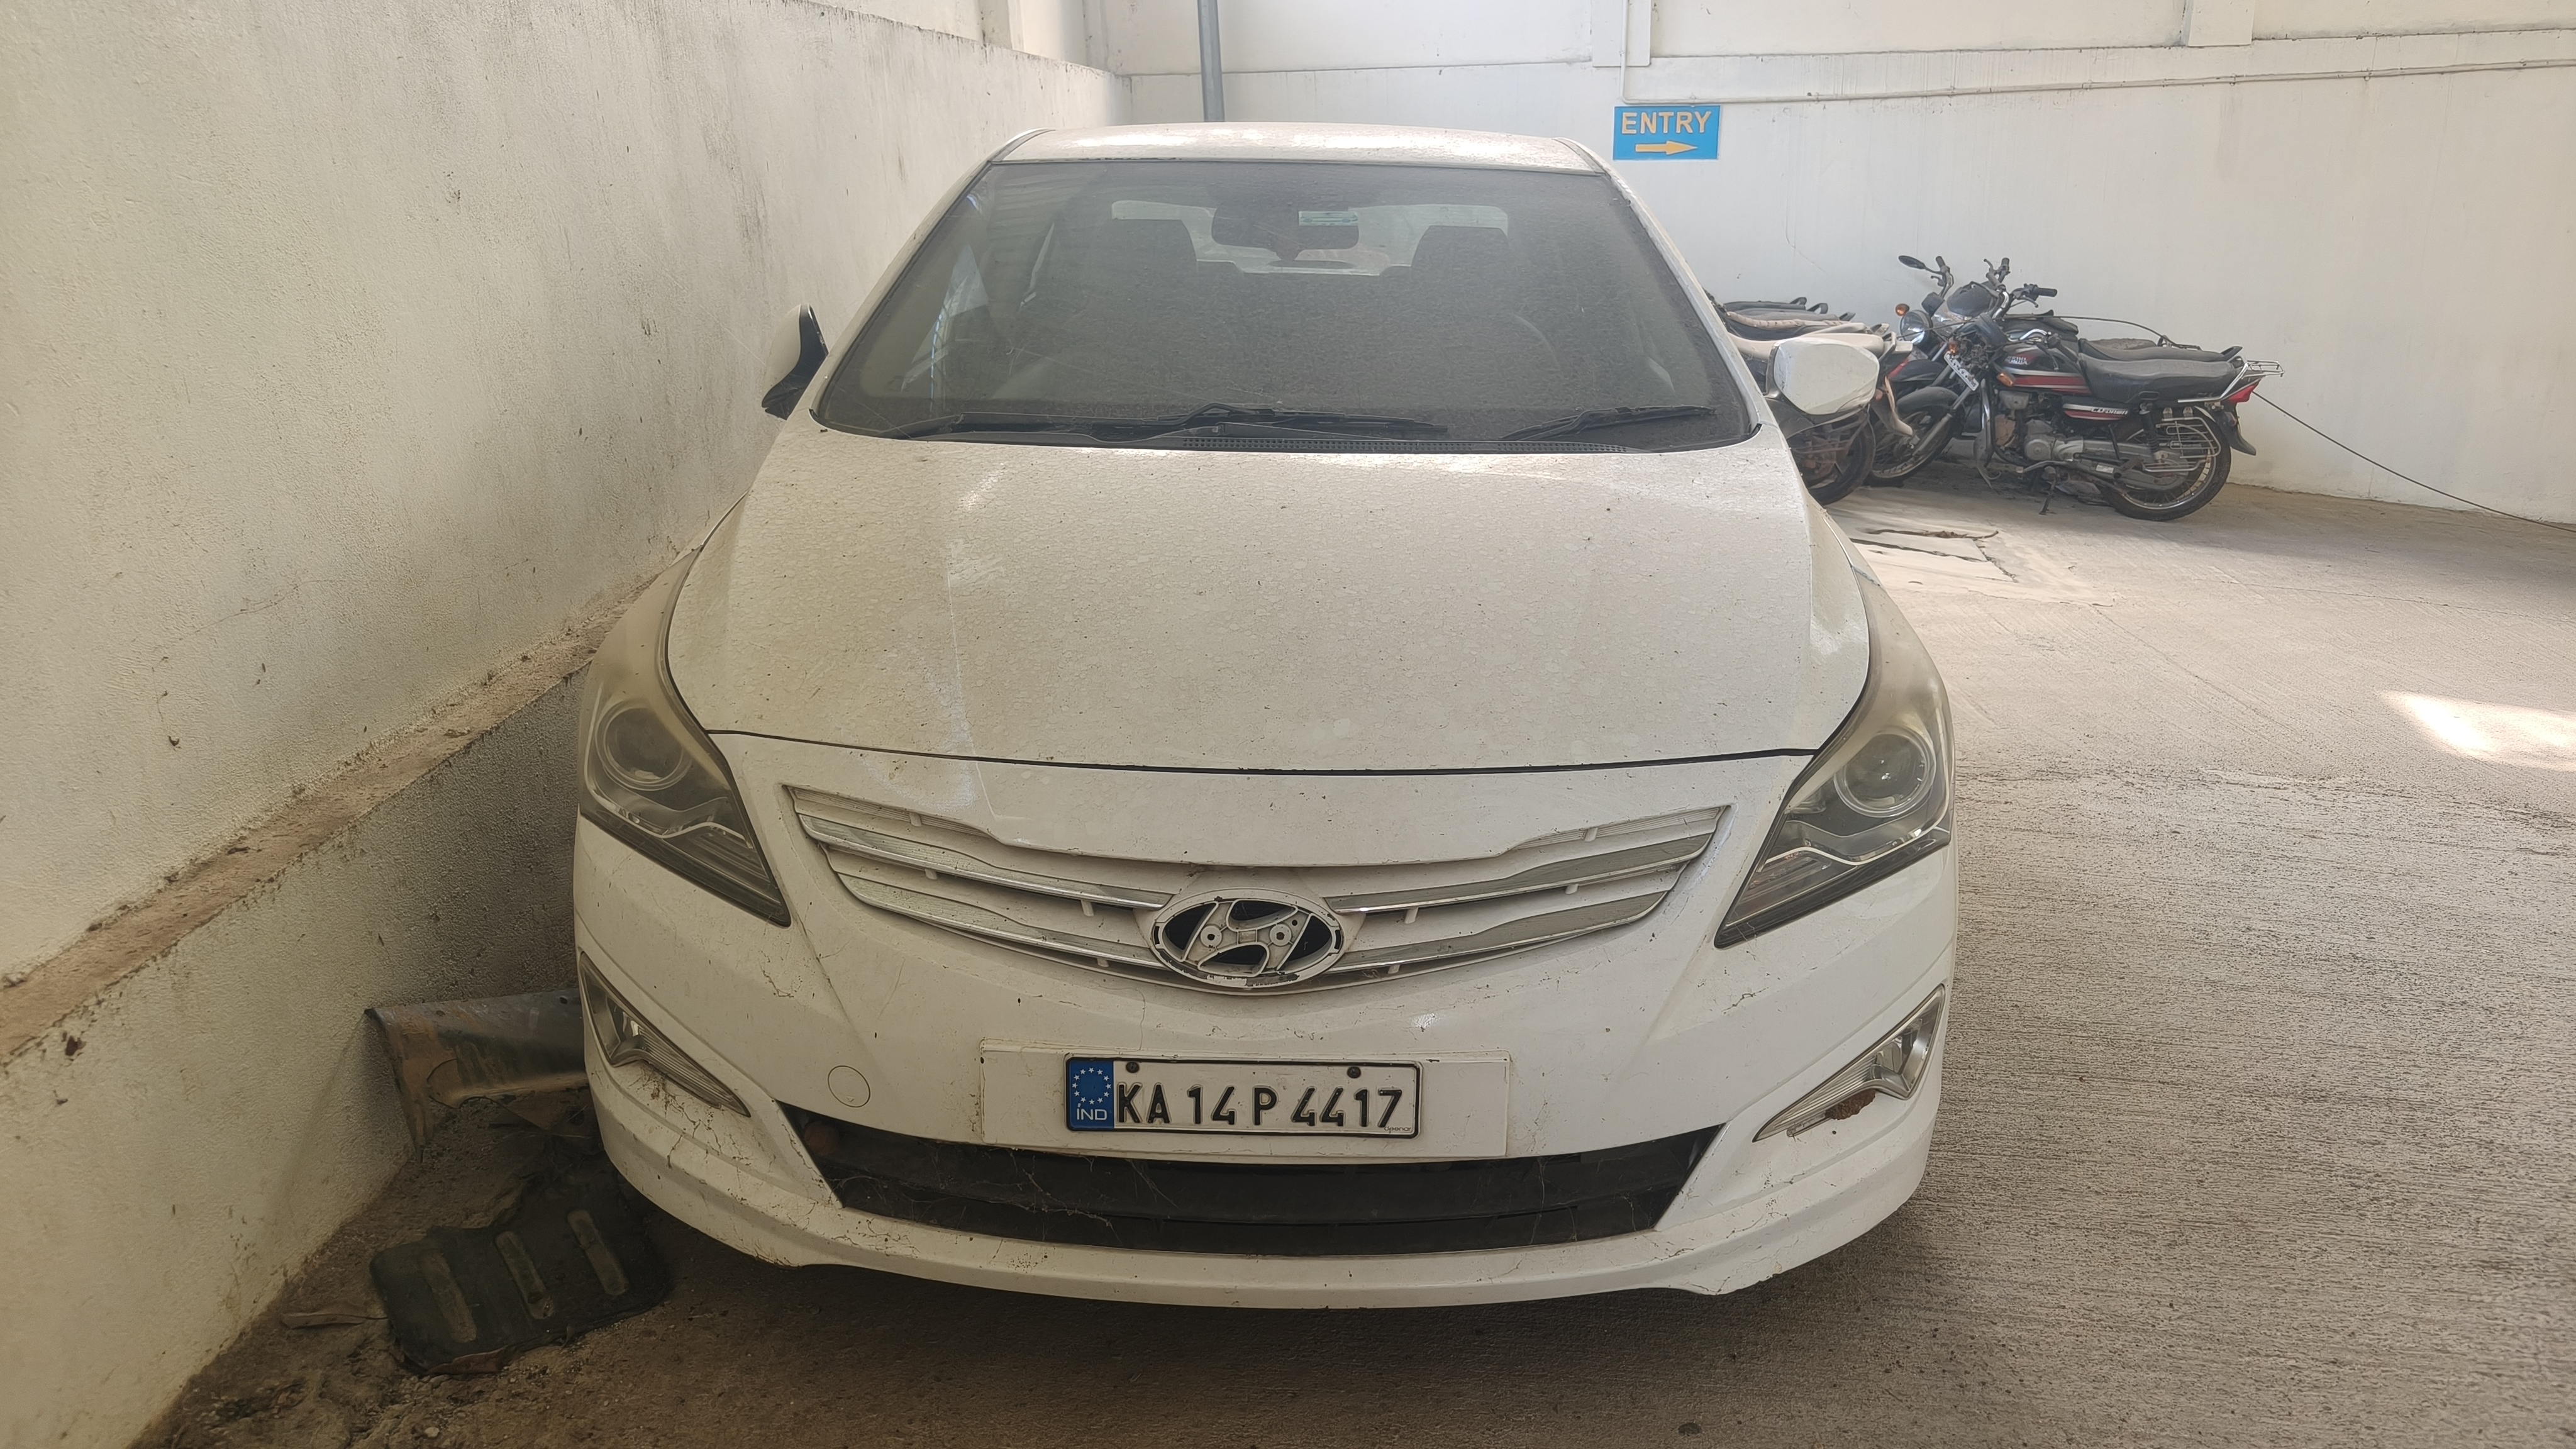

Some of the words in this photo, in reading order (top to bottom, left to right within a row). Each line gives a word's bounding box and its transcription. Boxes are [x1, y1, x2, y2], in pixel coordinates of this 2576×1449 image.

[1621, 111, 1712, 134] ENTRY
[1118, 1083, 1171, 1124] KA
[1188, 1085, 1236, 1126] 14
[1253, 1087, 1277, 1126] P
[1291, 1087, 1402, 1128] 4417
